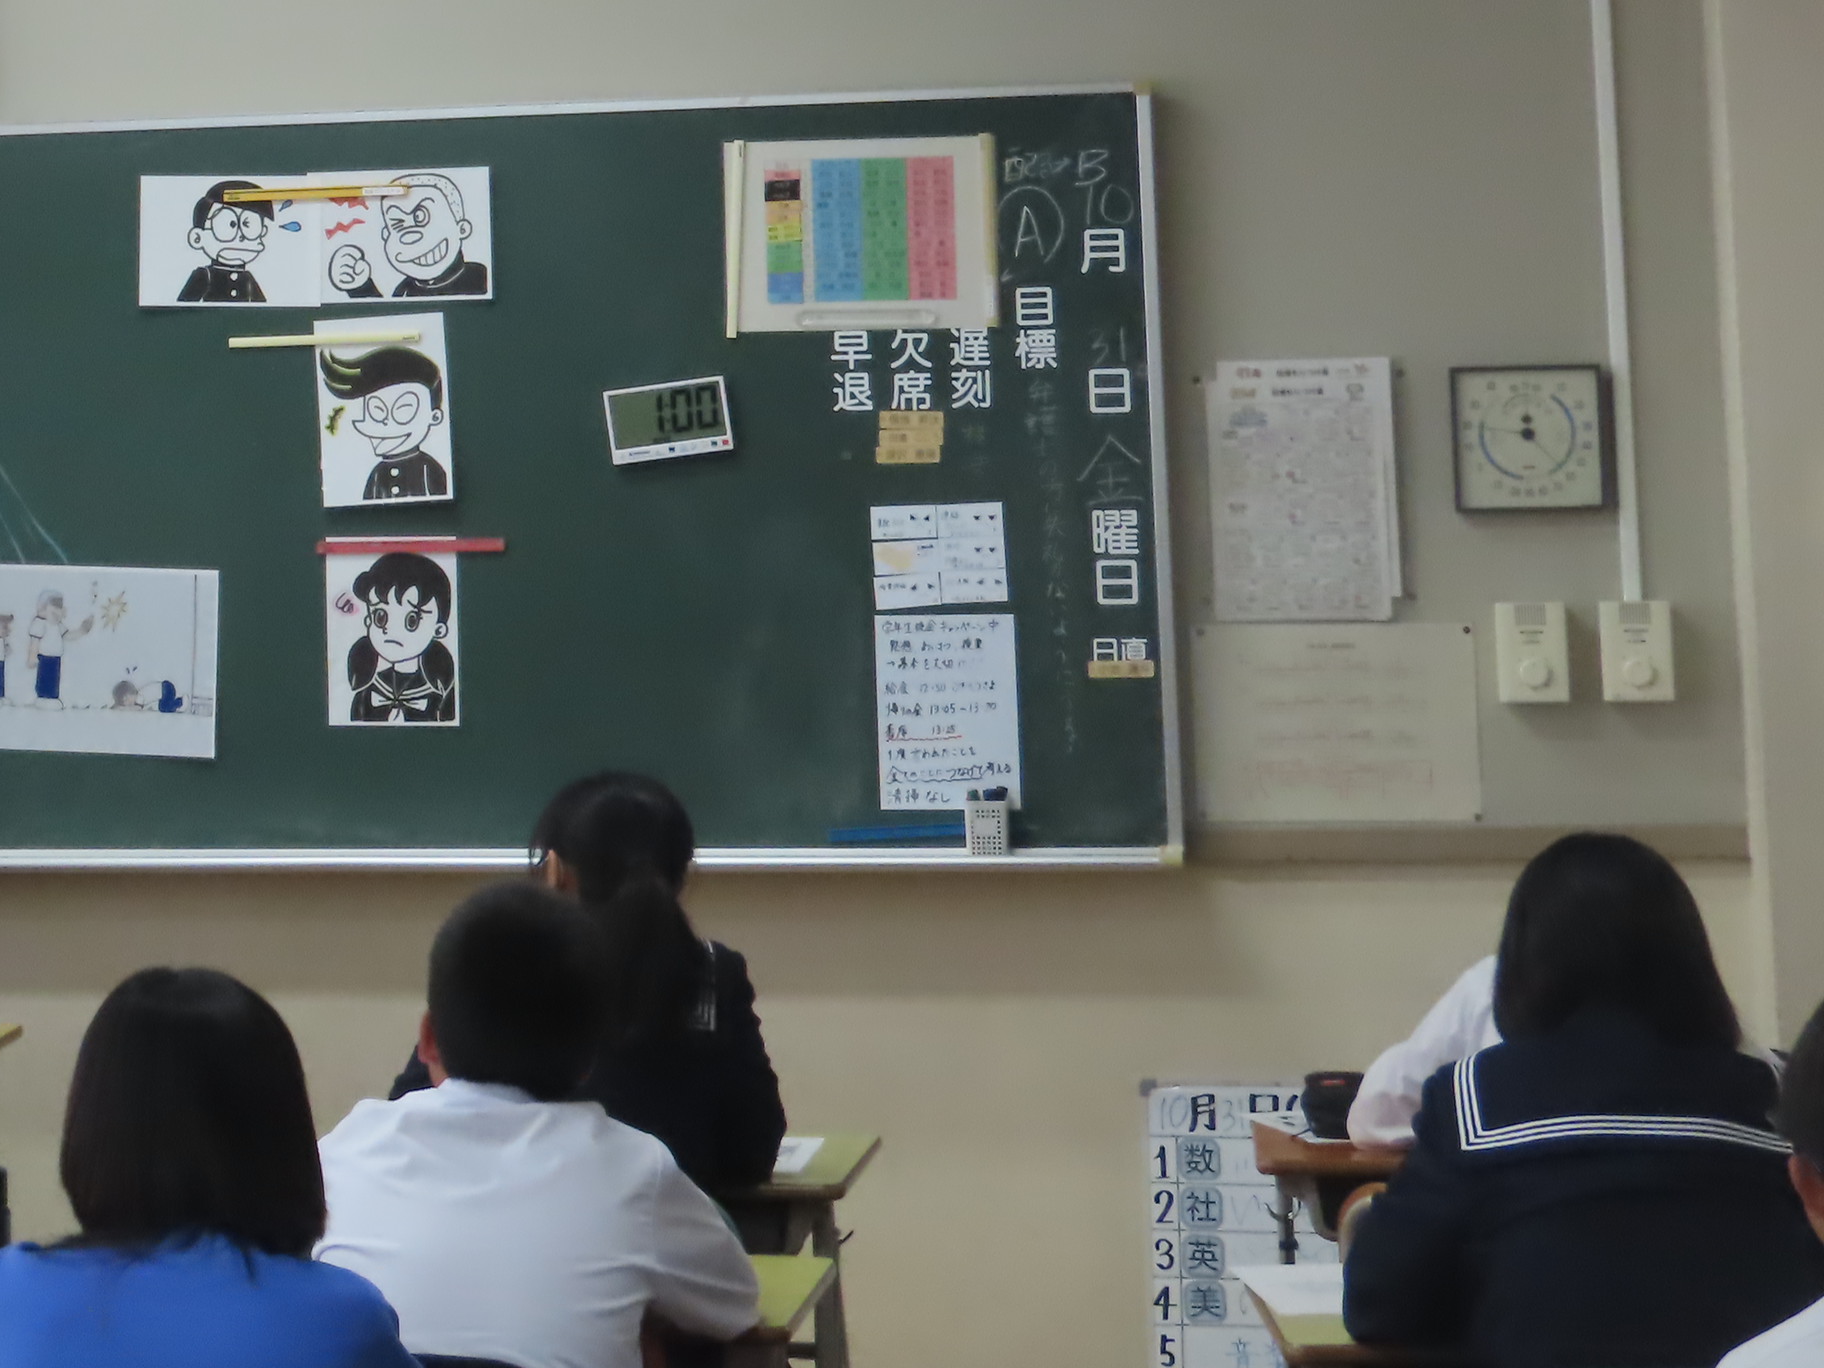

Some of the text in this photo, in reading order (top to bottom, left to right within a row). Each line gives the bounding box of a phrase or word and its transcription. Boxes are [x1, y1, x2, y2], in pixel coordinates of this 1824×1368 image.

[1086, 184, 1134, 225] 10
[1015, 205, 1044, 257] A
[1080, 228, 1126, 273] 月
[1015, 286, 1057, 370] 目標
[830, 330, 873, 412] 早退
[890, 329, 933, 411] 欠席
[950, 328, 991, 409] 遅刻
[1088, 367, 1132, 414] 日
[1091, 509, 1140, 605] 曜日
[1153, 1144, 1214, 1179] 1 数
[1153, 1190, 1175, 1224] 2
[1186, 1191, 1217, 1222] 社
[1155, 1238, 1218, 1271] 3 英
[1153, 1286, 1221, 1320] 4 美
[1160, 1334, 1176, 1367] 5
